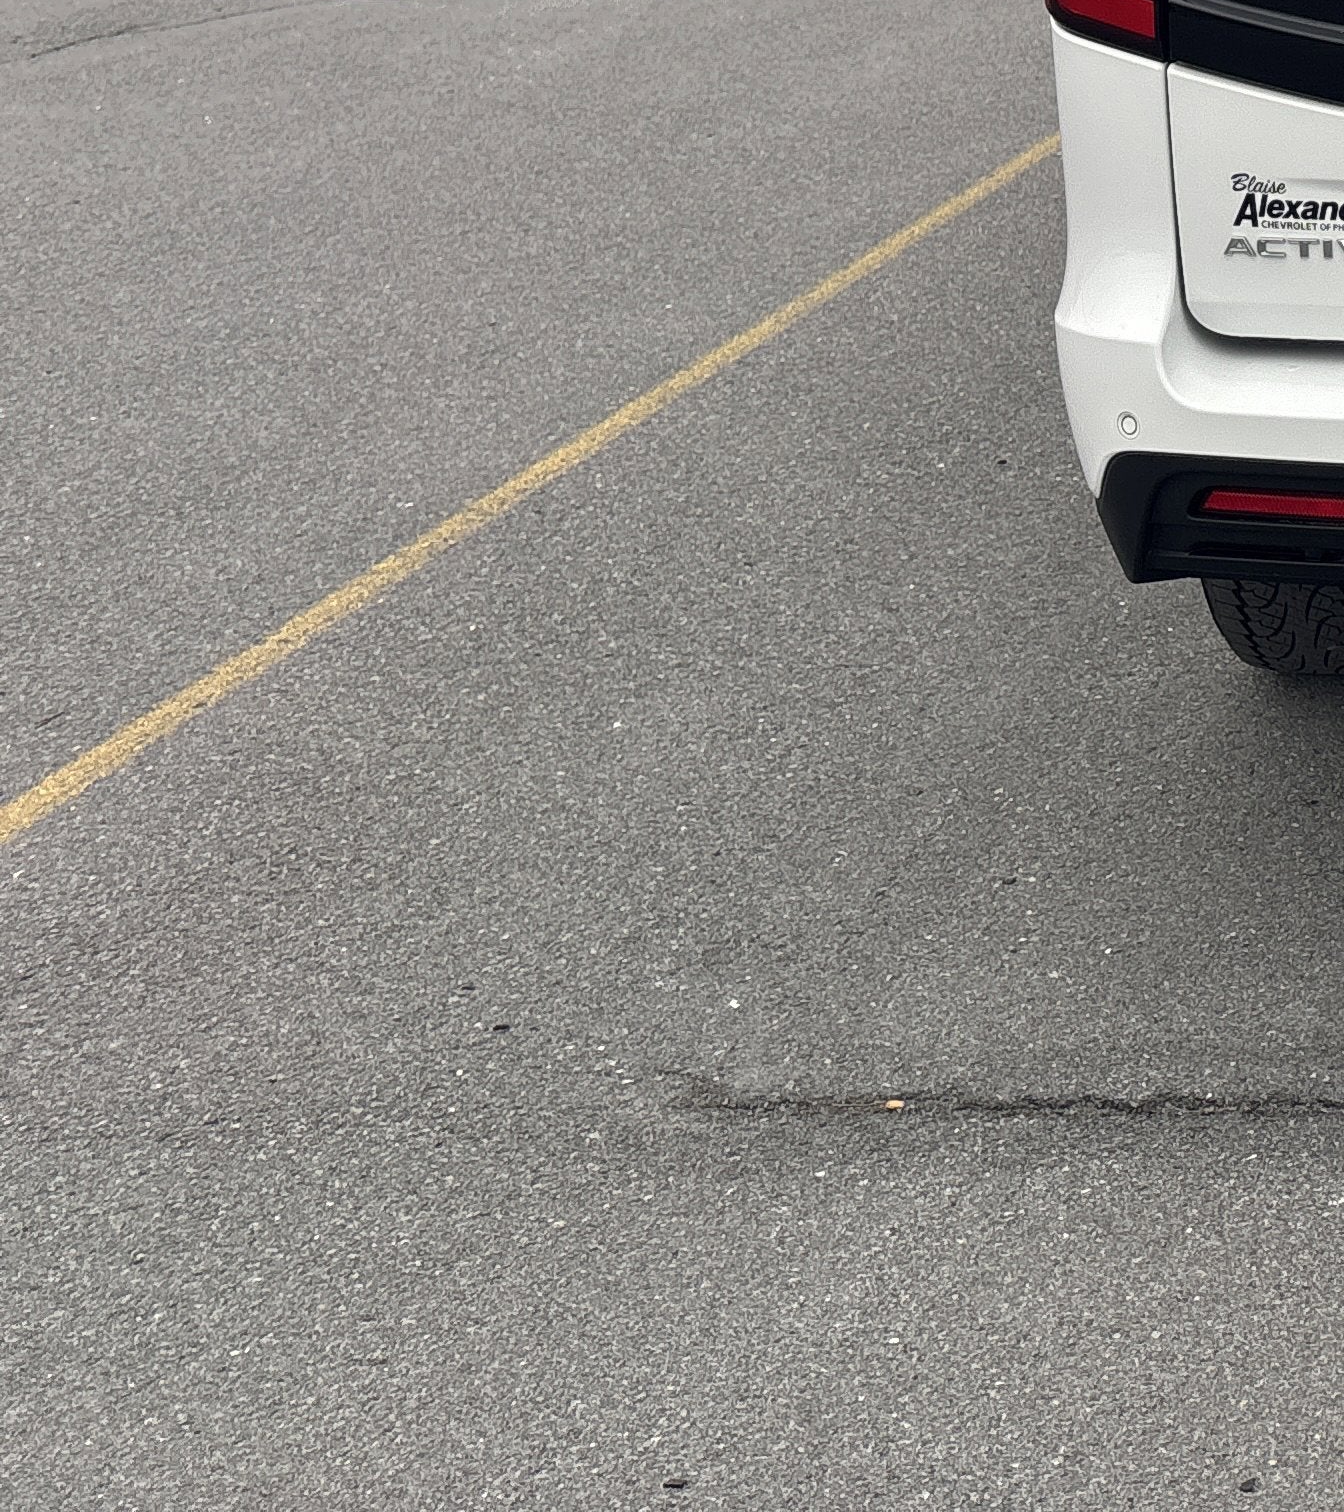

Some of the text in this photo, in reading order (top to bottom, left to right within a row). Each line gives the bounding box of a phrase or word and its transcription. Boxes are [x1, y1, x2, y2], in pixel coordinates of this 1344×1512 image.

[1230, 172, 1287, 195] Blaise
[1261, 220, 1318, 232] CHEVROLET
[1319, 223, 1332, 232] OF
